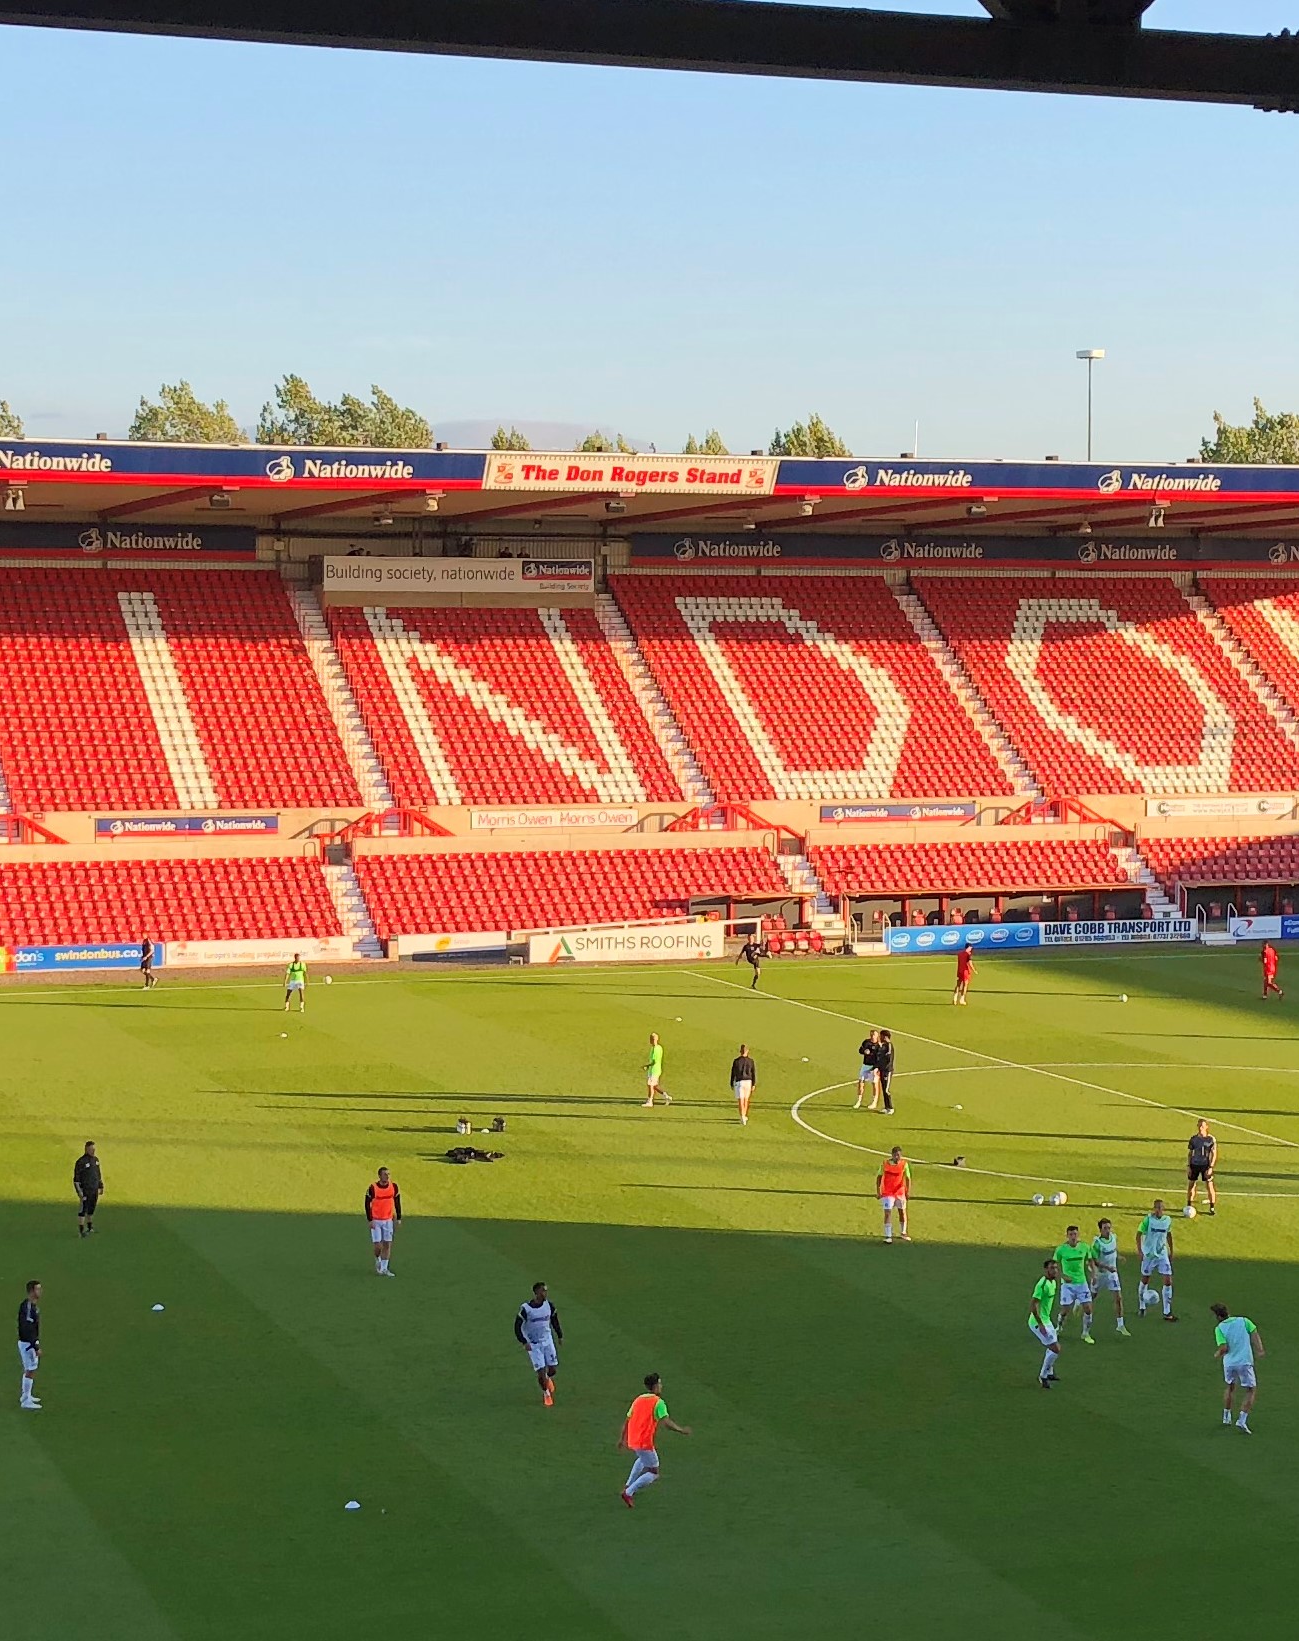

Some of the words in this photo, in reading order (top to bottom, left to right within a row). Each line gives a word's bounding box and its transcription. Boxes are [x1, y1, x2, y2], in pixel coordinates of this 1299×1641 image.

[303, 458, 414, 479] Nationwide
[521, 464, 559, 481] The
[566, 466, 603, 482] Don
[611, 467, 679, 486] Rogers
[686, 468, 742, 484] Stand
[875, 468, 972, 489] Nationwide
[1128, 473, 1221, 492] Nationwide
[106, 530, 202, 550] Nationwide
[697, 538, 782, 559] Nationwide
[903, 540, 984, 560] Nationwide
[1100, 543, 1177, 562] Nationwide
[326, 565, 382, 582] Building
[387, 566, 436, 582] society,
[441, 567, 515, 581] nationwide
[539, 565, 590, 576] Nationwide
[478, 814, 515, 826] Morris
[518, 813, 552, 825] Owen
[598, 811, 632, 823] Owen
[845, 808, 888, 817] Nationwide
[923, 807, 965, 816] Nationwide
[125, 821, 176, 831] Nationwide
[216, 820, 266, 830] Nationwide
[1044, 923, 1072, 935] DAVE
[1074, 922, 1104, 934] COBB
[1107, 921, 1170, 933] TRANSPORT
[1173, 921, 1191, 932] LTD
[576, 937, 635, 950] SMITHS
[641, 935, 712, 948] ROOFING
